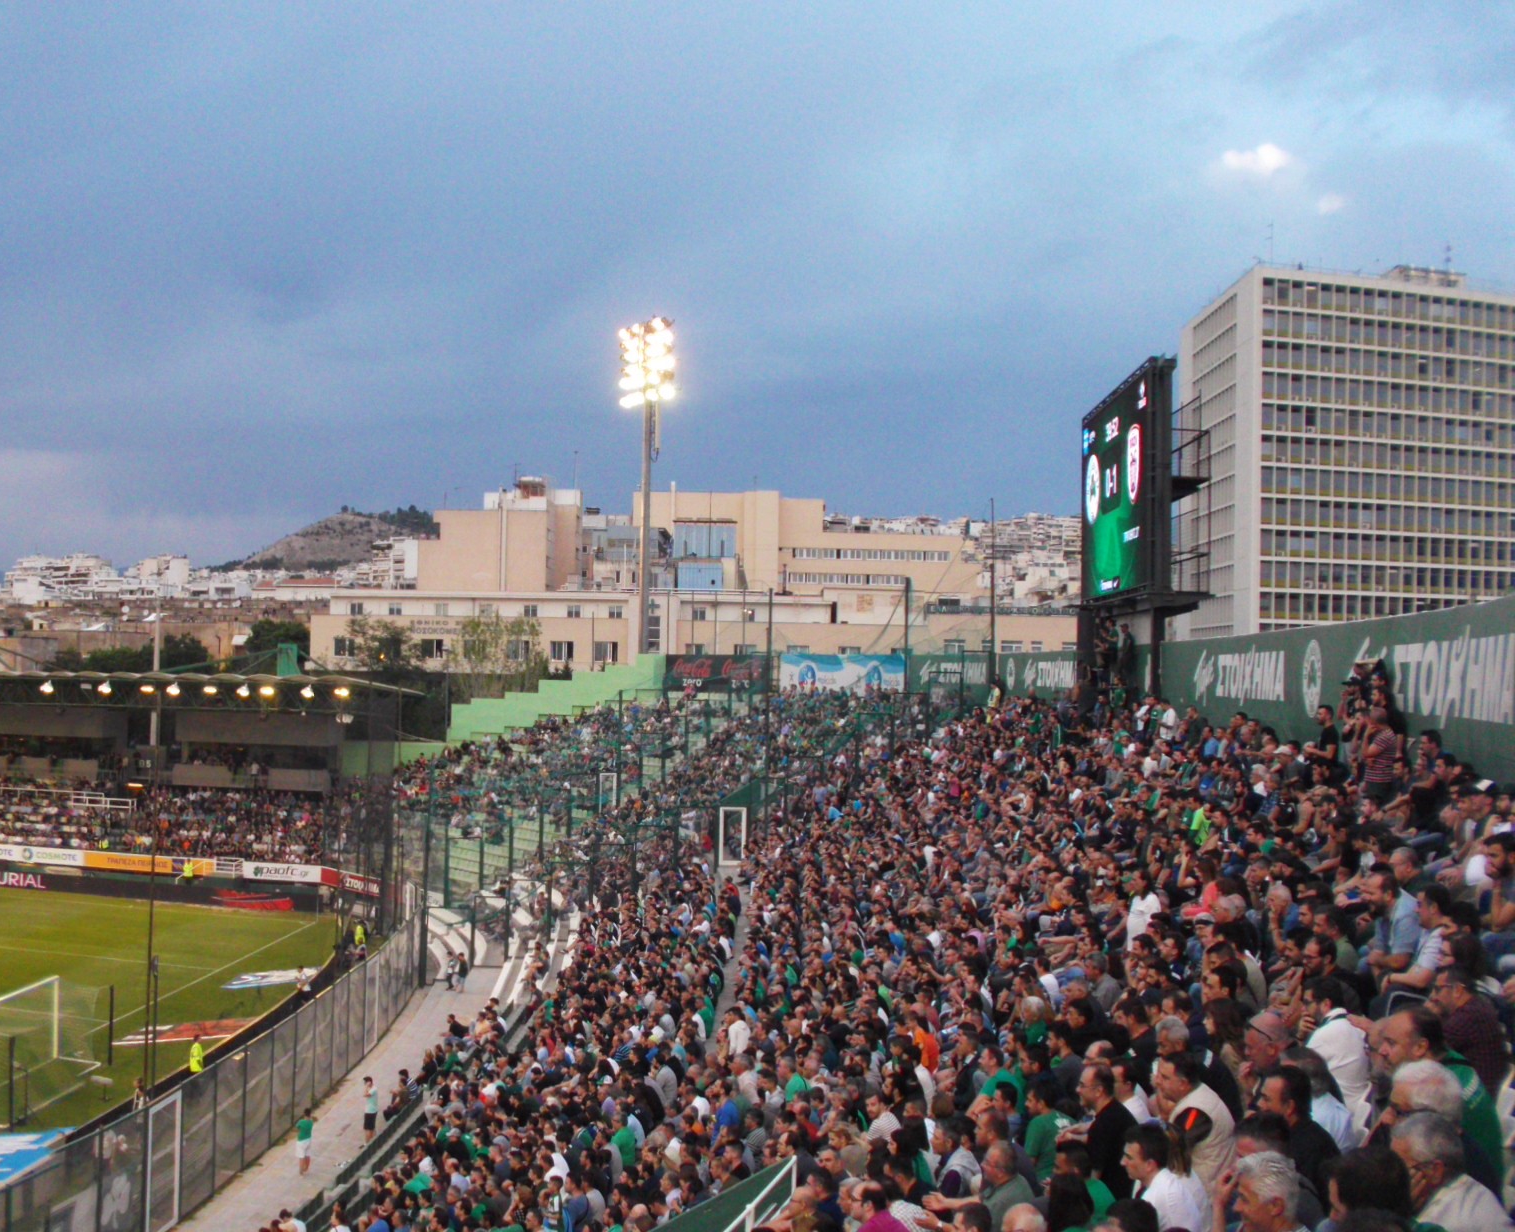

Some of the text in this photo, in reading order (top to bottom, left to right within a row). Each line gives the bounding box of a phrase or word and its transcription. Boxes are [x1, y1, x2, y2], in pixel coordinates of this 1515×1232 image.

[1215, 644, 1285, 706] ΣΤΟΙΧΗΜΑ
[1392, 624, 1515, 730] ΣΤΟΙΧΗΜΑ
[35, 851, 78, 862] COSMOTE
